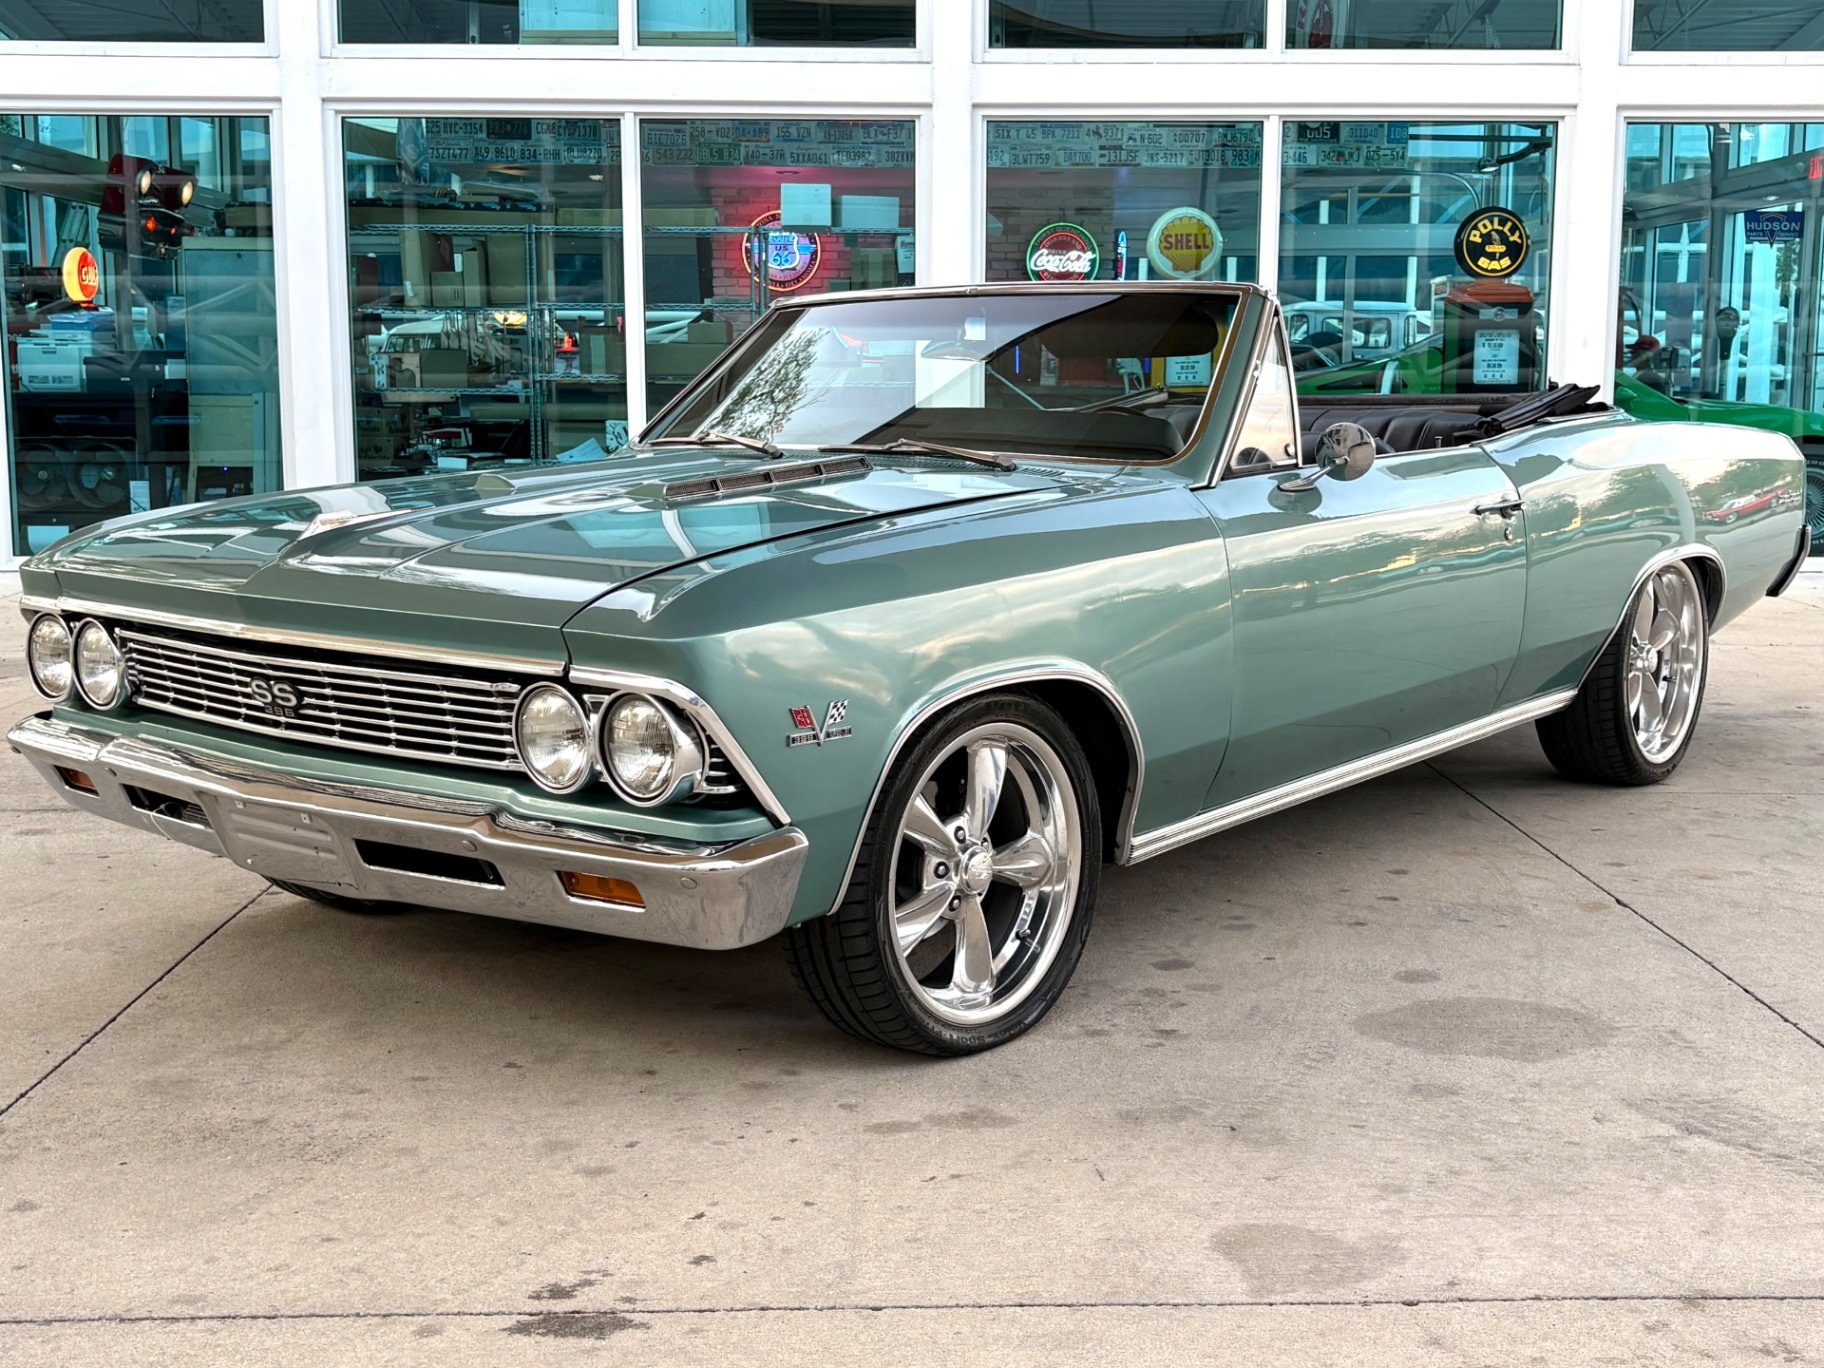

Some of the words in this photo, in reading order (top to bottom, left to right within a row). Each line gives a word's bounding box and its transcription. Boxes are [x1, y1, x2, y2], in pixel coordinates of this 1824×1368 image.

[1469, 216, 1522, 244] POLLY
[1746, 221, 1800, 231] HUDSON
[1163, 233, 1209, 250] SHELL
[771, 251, 791, 266] 66
[1477, 256, 1511, 270] GAS
[251, 680, 298, 706] SS
[264, 705, 295, 717] 396
